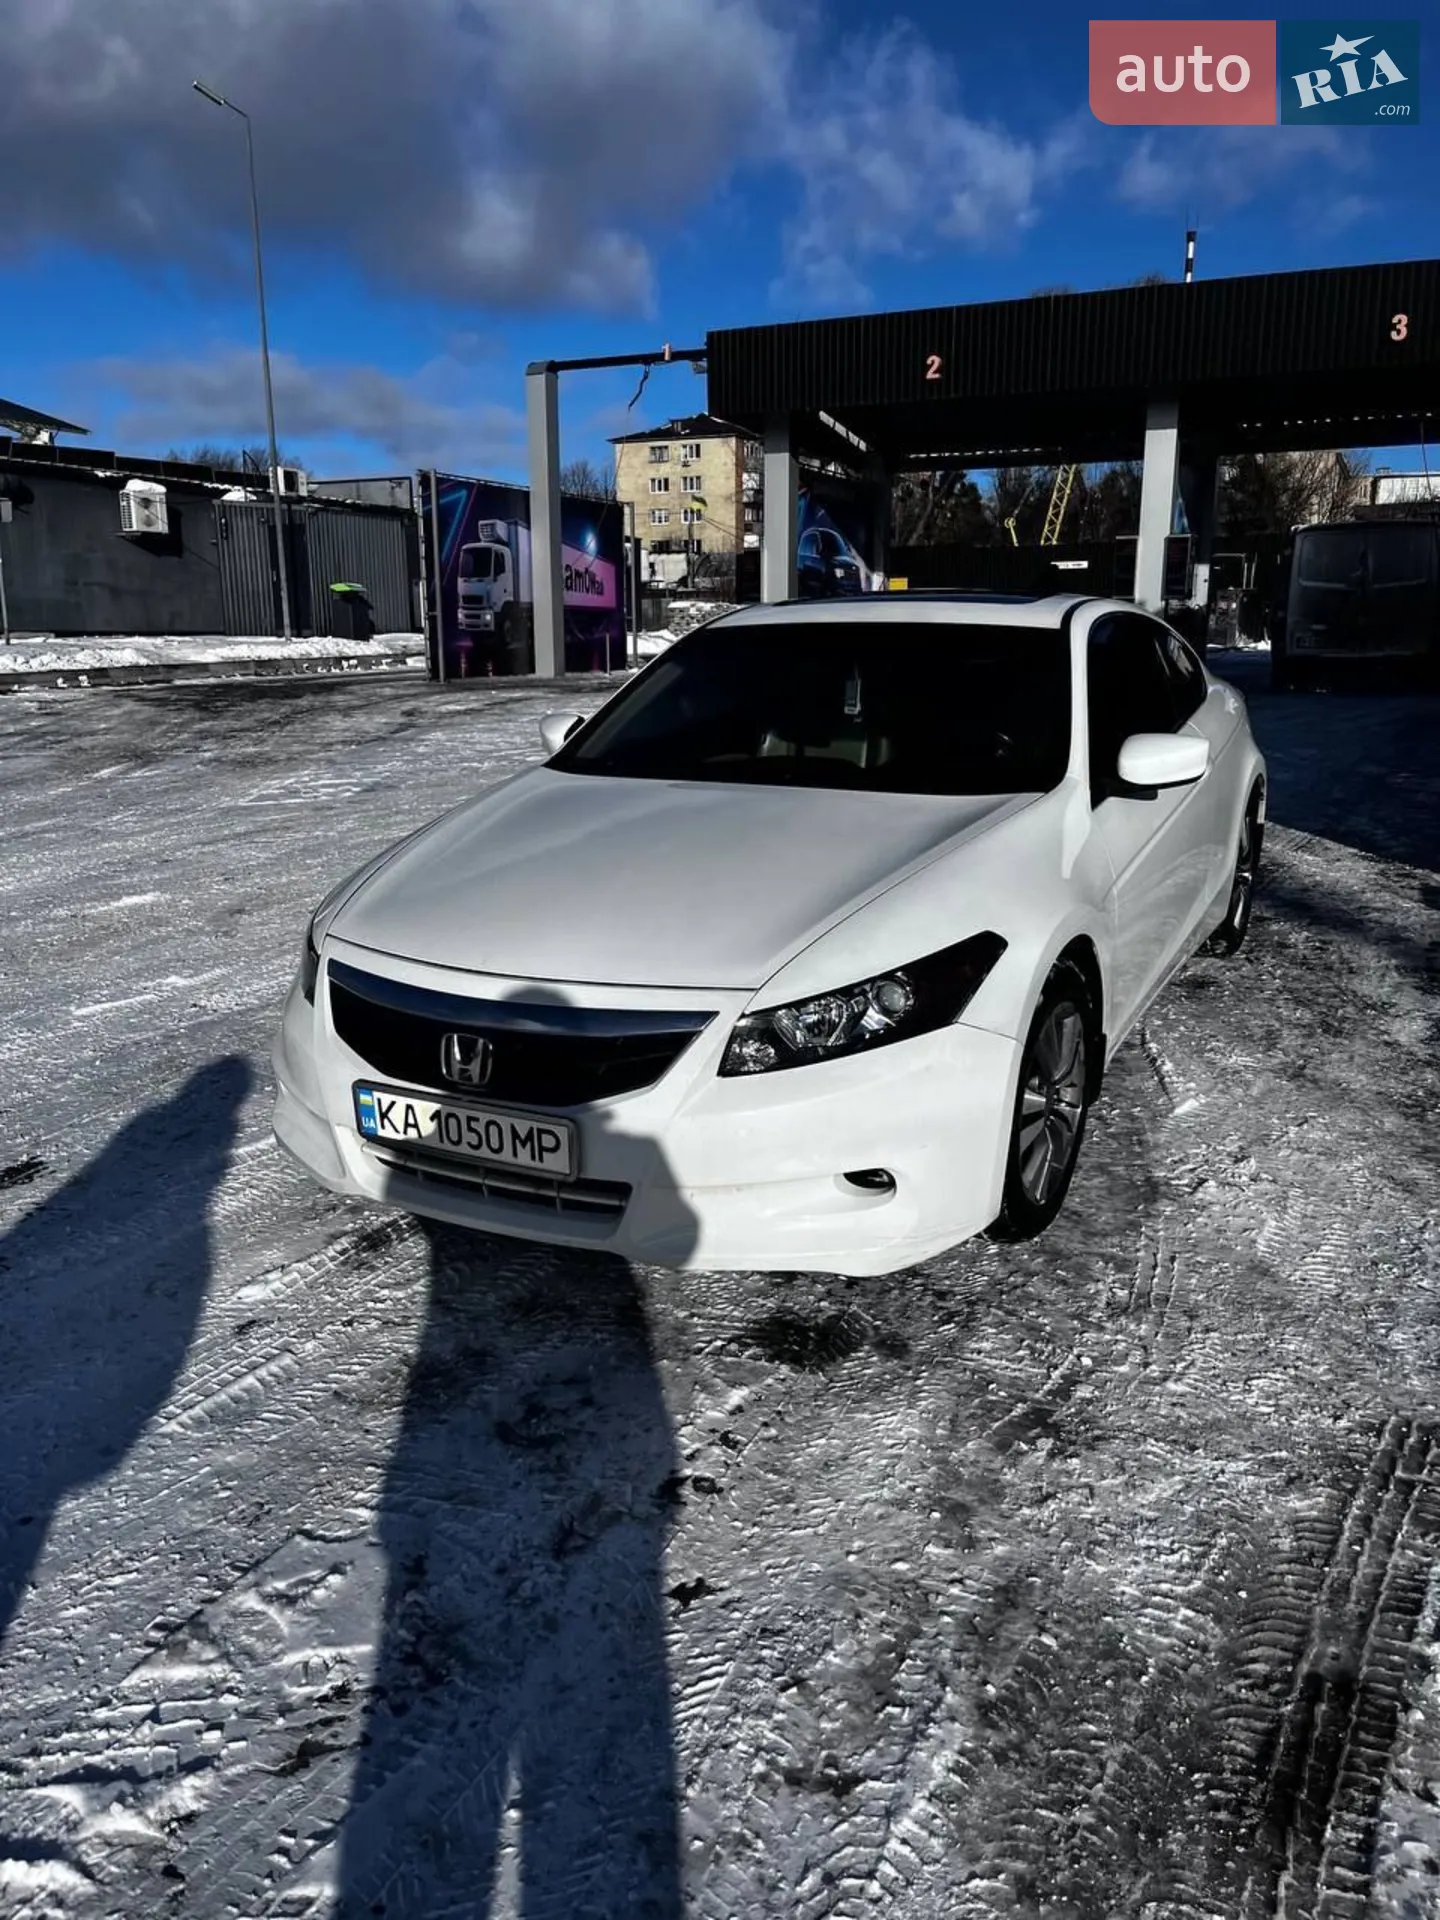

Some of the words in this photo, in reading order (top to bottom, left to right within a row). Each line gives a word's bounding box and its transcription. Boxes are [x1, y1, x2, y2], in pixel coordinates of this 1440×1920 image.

[1391, 314, 1408, 341] 3
[661, 342, 671, 361] 1
[926, 354, 942, 379] 2
[362, 1116, 376, 1129] UA
[377, 1097, 424, 1139] KA
[429, 1109, 505, 1154] 1050
[510, 1122, 561, 1163] MP
